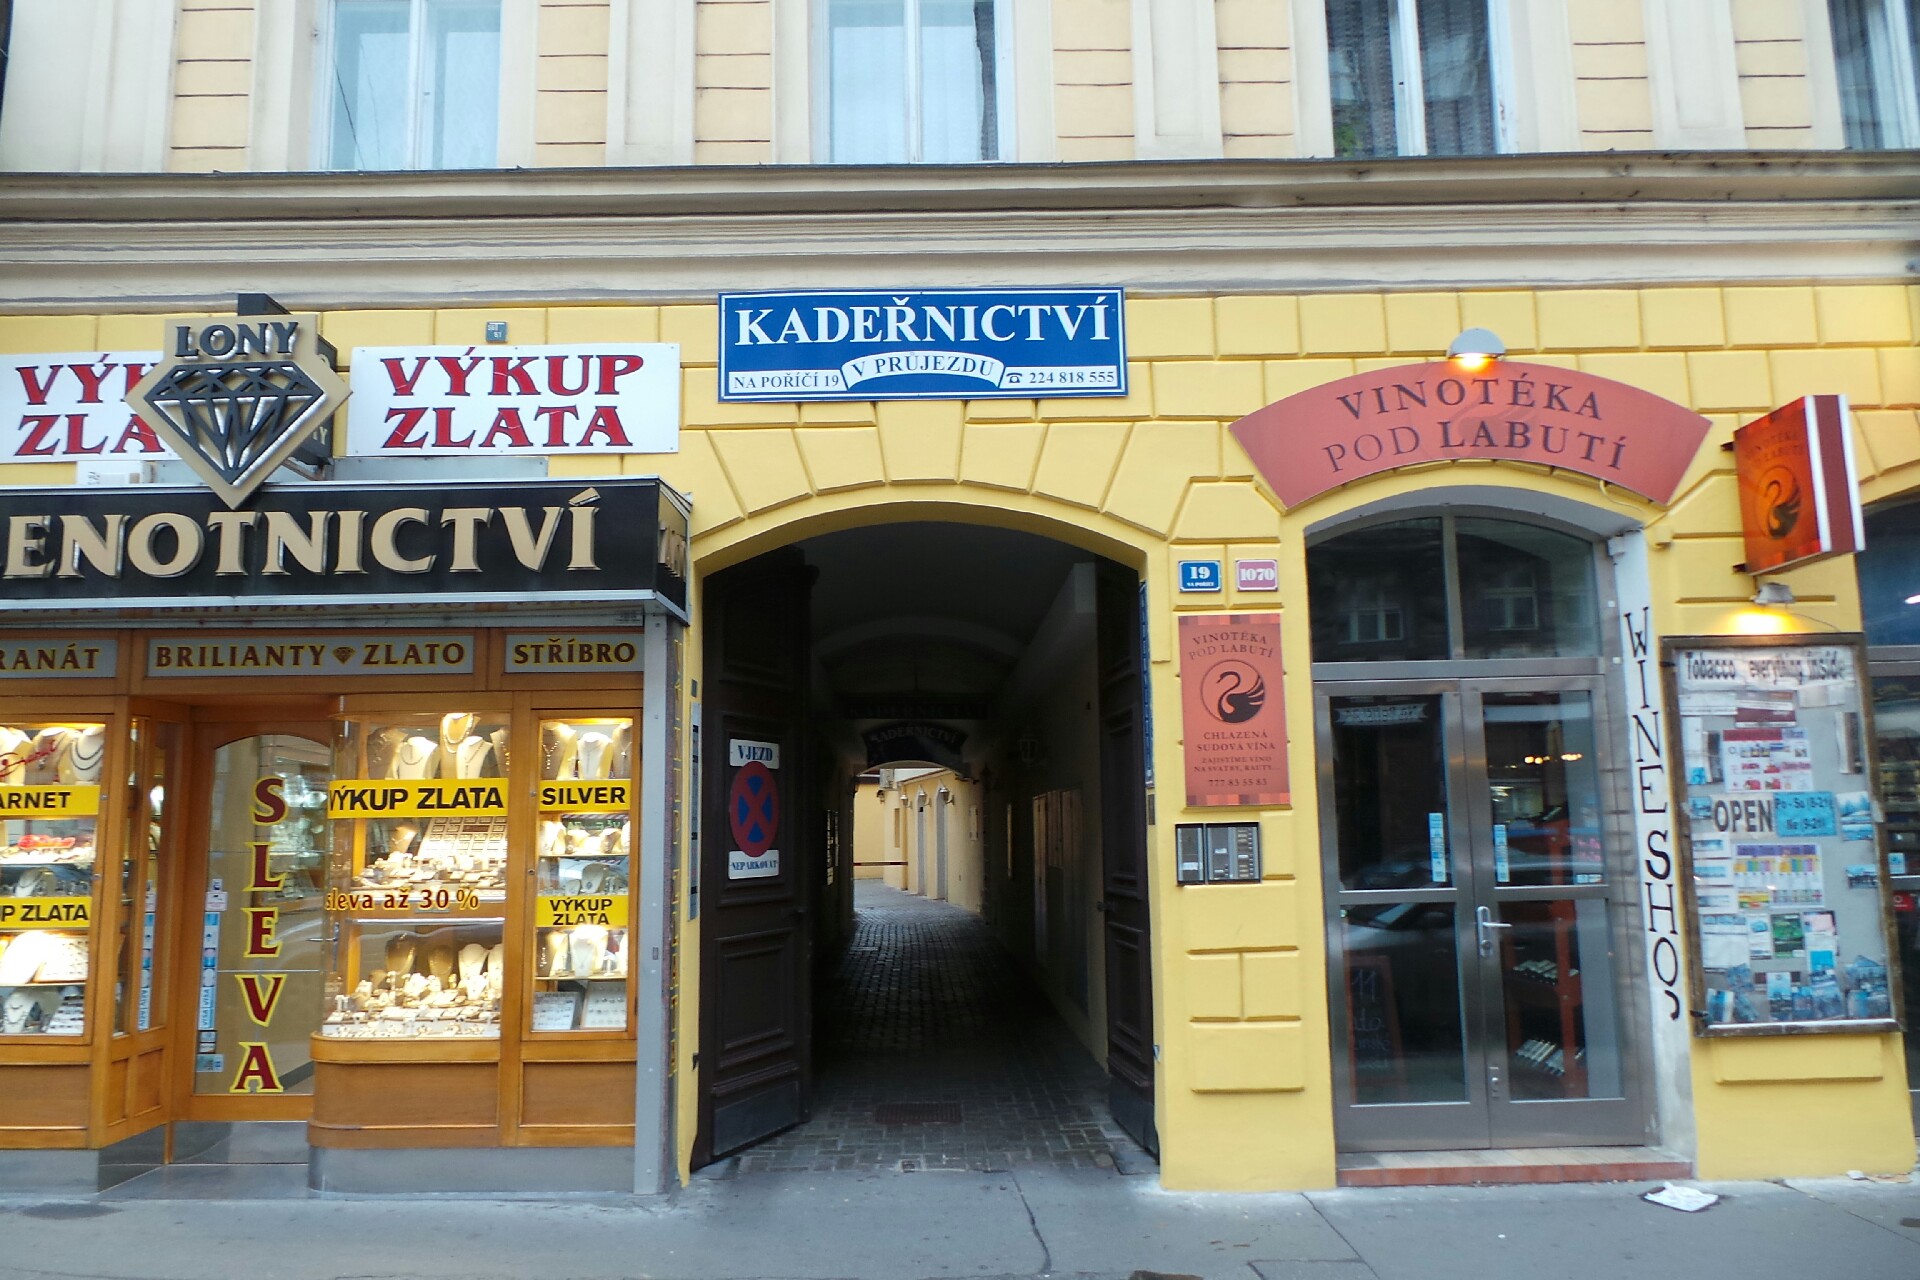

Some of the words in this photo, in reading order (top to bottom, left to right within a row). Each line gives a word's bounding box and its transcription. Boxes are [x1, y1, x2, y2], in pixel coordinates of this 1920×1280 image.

[735, 296, 1111, 346] KADEŘNICTVÍ
[175, 320, 300, 361] LONY
[380, 346, 644, 397] VÝKUP
[851, 361, 866, 377] V
[875, 352, 994, 377] PRŮJEZDU
[734, 376, 756, 388] NA
[761, 372, 818, 388] POŘÍČÍ
[824, 374, 839, 387] 19
[1029, 372, 1054, 384] 224
[1059, 371, 1084, 383] 818
[1089, 371, 1115, 383] 555
[1336, 372, 1602, 420] VINOTÉKA
[383, 405, 634, 449] ZLATA
[1324, 426, 1420, 473] POD
[1438, 420, 1627, 470] LABUTÍ
[2, 487, 602, 580] ENOTNICTVÍ
[1190, 566, 1211, 579] 19
[1239, 568, 1275, 581] 1070
[1193, 631, 1267, 644] VINOTÉKA
[156, 643, 325, 669] BRILIANTY
[362, 642, 465, 665] ZLATO
[513, 638, 636, 664] STŘÍBRO
[1189, 646, 1216, 660] POD
[1221, 644, 1273, 658] LABUTÍ
[1685, 651, 1735, 680] Tobacco
[1624, 607, 1667, 813] WINE
[1203, 730, 1268, 740] CHLAZENÁ
[738, 745, 773, 761] VJEZD
[329, 785, 408, 811] VÝKUP
[417, 787, 504, 809] ZLATA
[541, 786, 626, 805] SILVER
[1714, 799, 1773, 833] OPEN
[732, 860, 777, 871] NEPARKOVAT
[326, 887, 373, 911] sleva
[383, 886, 410, 910] až
[418, 888, 450, 910] 30
[455, 888, 480, 911] %
[550, 897, 613, 912] VÝKUP
[20, 904, 89, 922] ZLATA
[553, 912, 611, 926] ZLATA
[229, 775, 289, 1093] SLEVA
